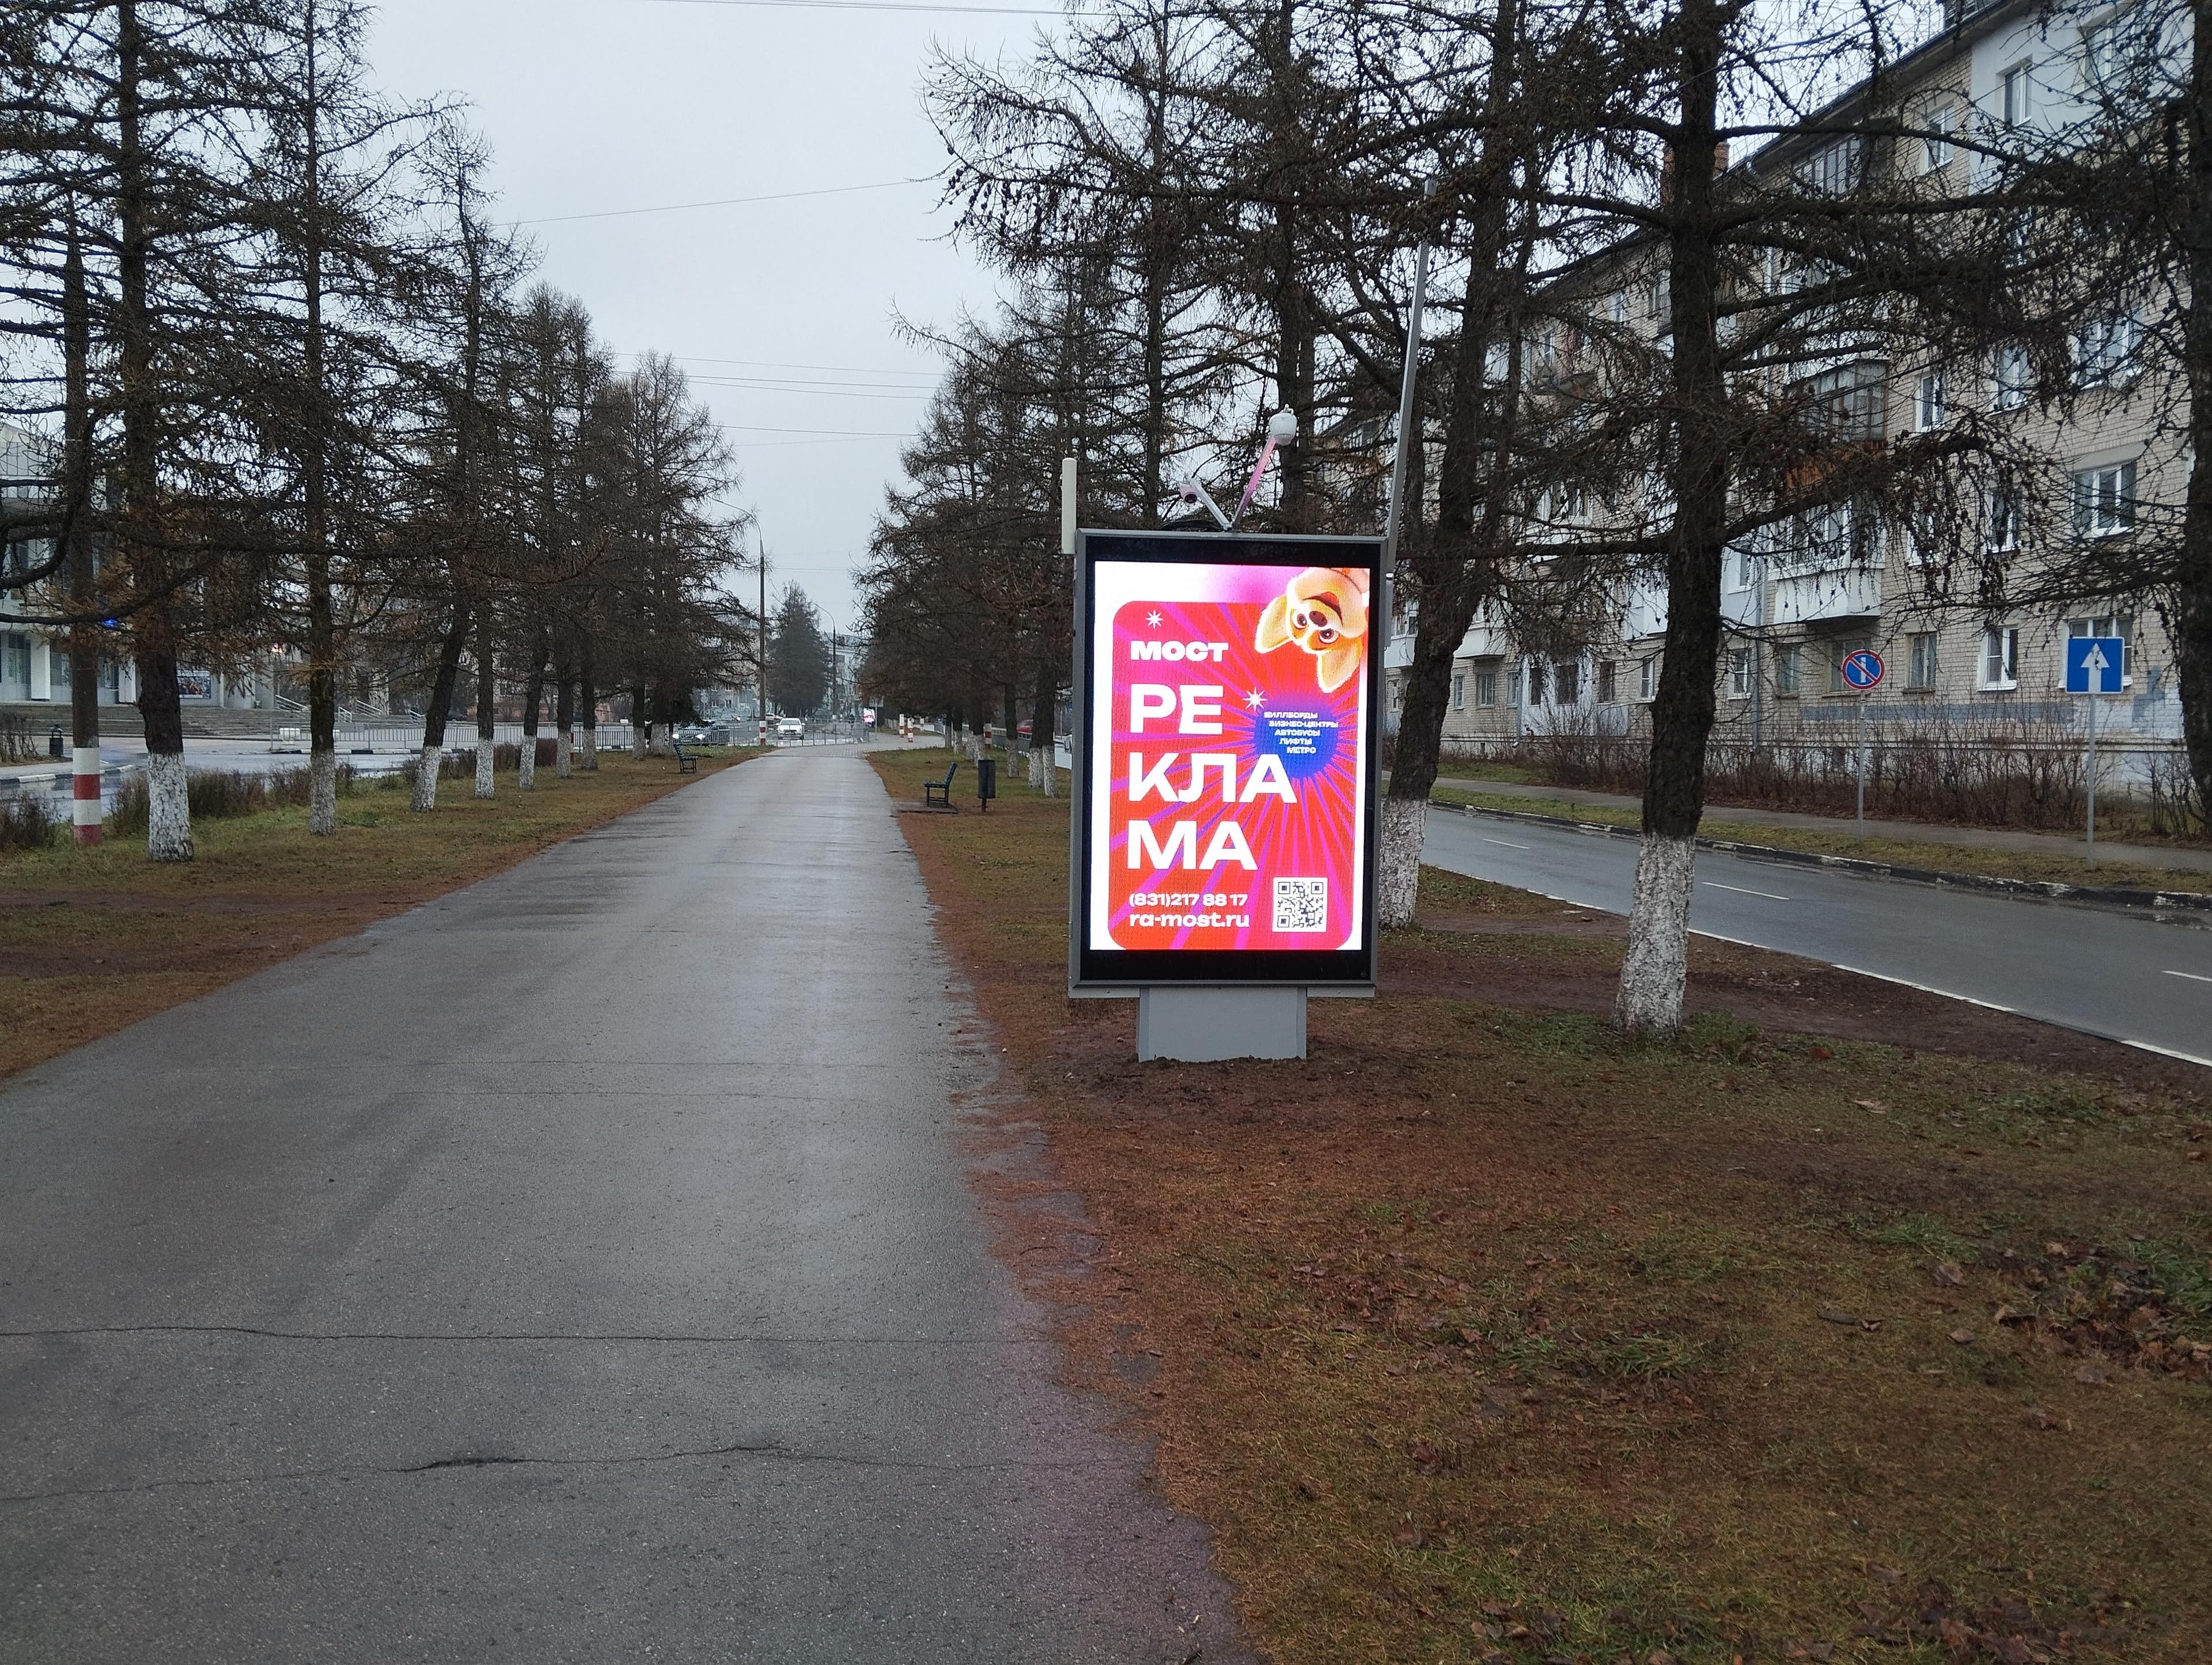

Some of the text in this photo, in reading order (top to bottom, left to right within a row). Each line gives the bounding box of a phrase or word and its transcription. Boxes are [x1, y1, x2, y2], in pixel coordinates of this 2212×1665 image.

[1130, 640, 1229, 662] МОСТ
[1130, 683, 1224, 735] РЕ
[1264, 711, 1318, 719] БИЛЛБОРДЫ
[1274, 729, 1321, 737] АВТОБУСЫ
[1279, 737, 1313, 745] ЛИФТЫ
[1286, 746, 1317, 754] МЕТРО
[1128, 752, 1298, 803] КЛА
[1127, 820, 1259, 871] МА
[1202, 893, 1228, 907] 88
[1229, 893, 1249, 907] 17
[1129, 912, 1250, 927] ra-most.ru
